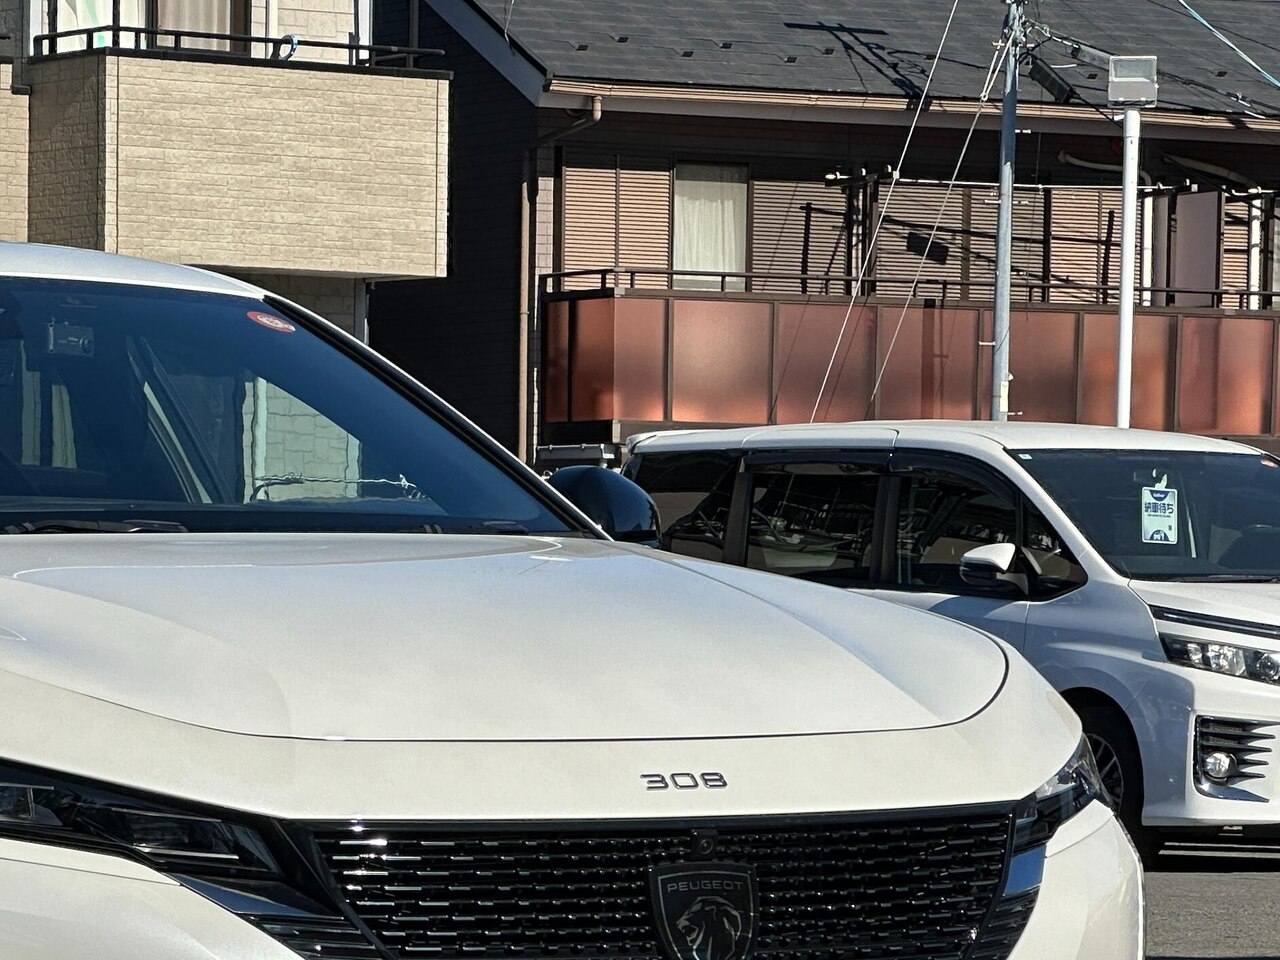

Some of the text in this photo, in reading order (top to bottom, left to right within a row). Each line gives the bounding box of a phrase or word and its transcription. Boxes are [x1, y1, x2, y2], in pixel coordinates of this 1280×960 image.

[1144, 501, 1174, 514] 納車待ち
[639, 772, 728, 791] 308
[667, 880, 744, 893] PEUGEOT
